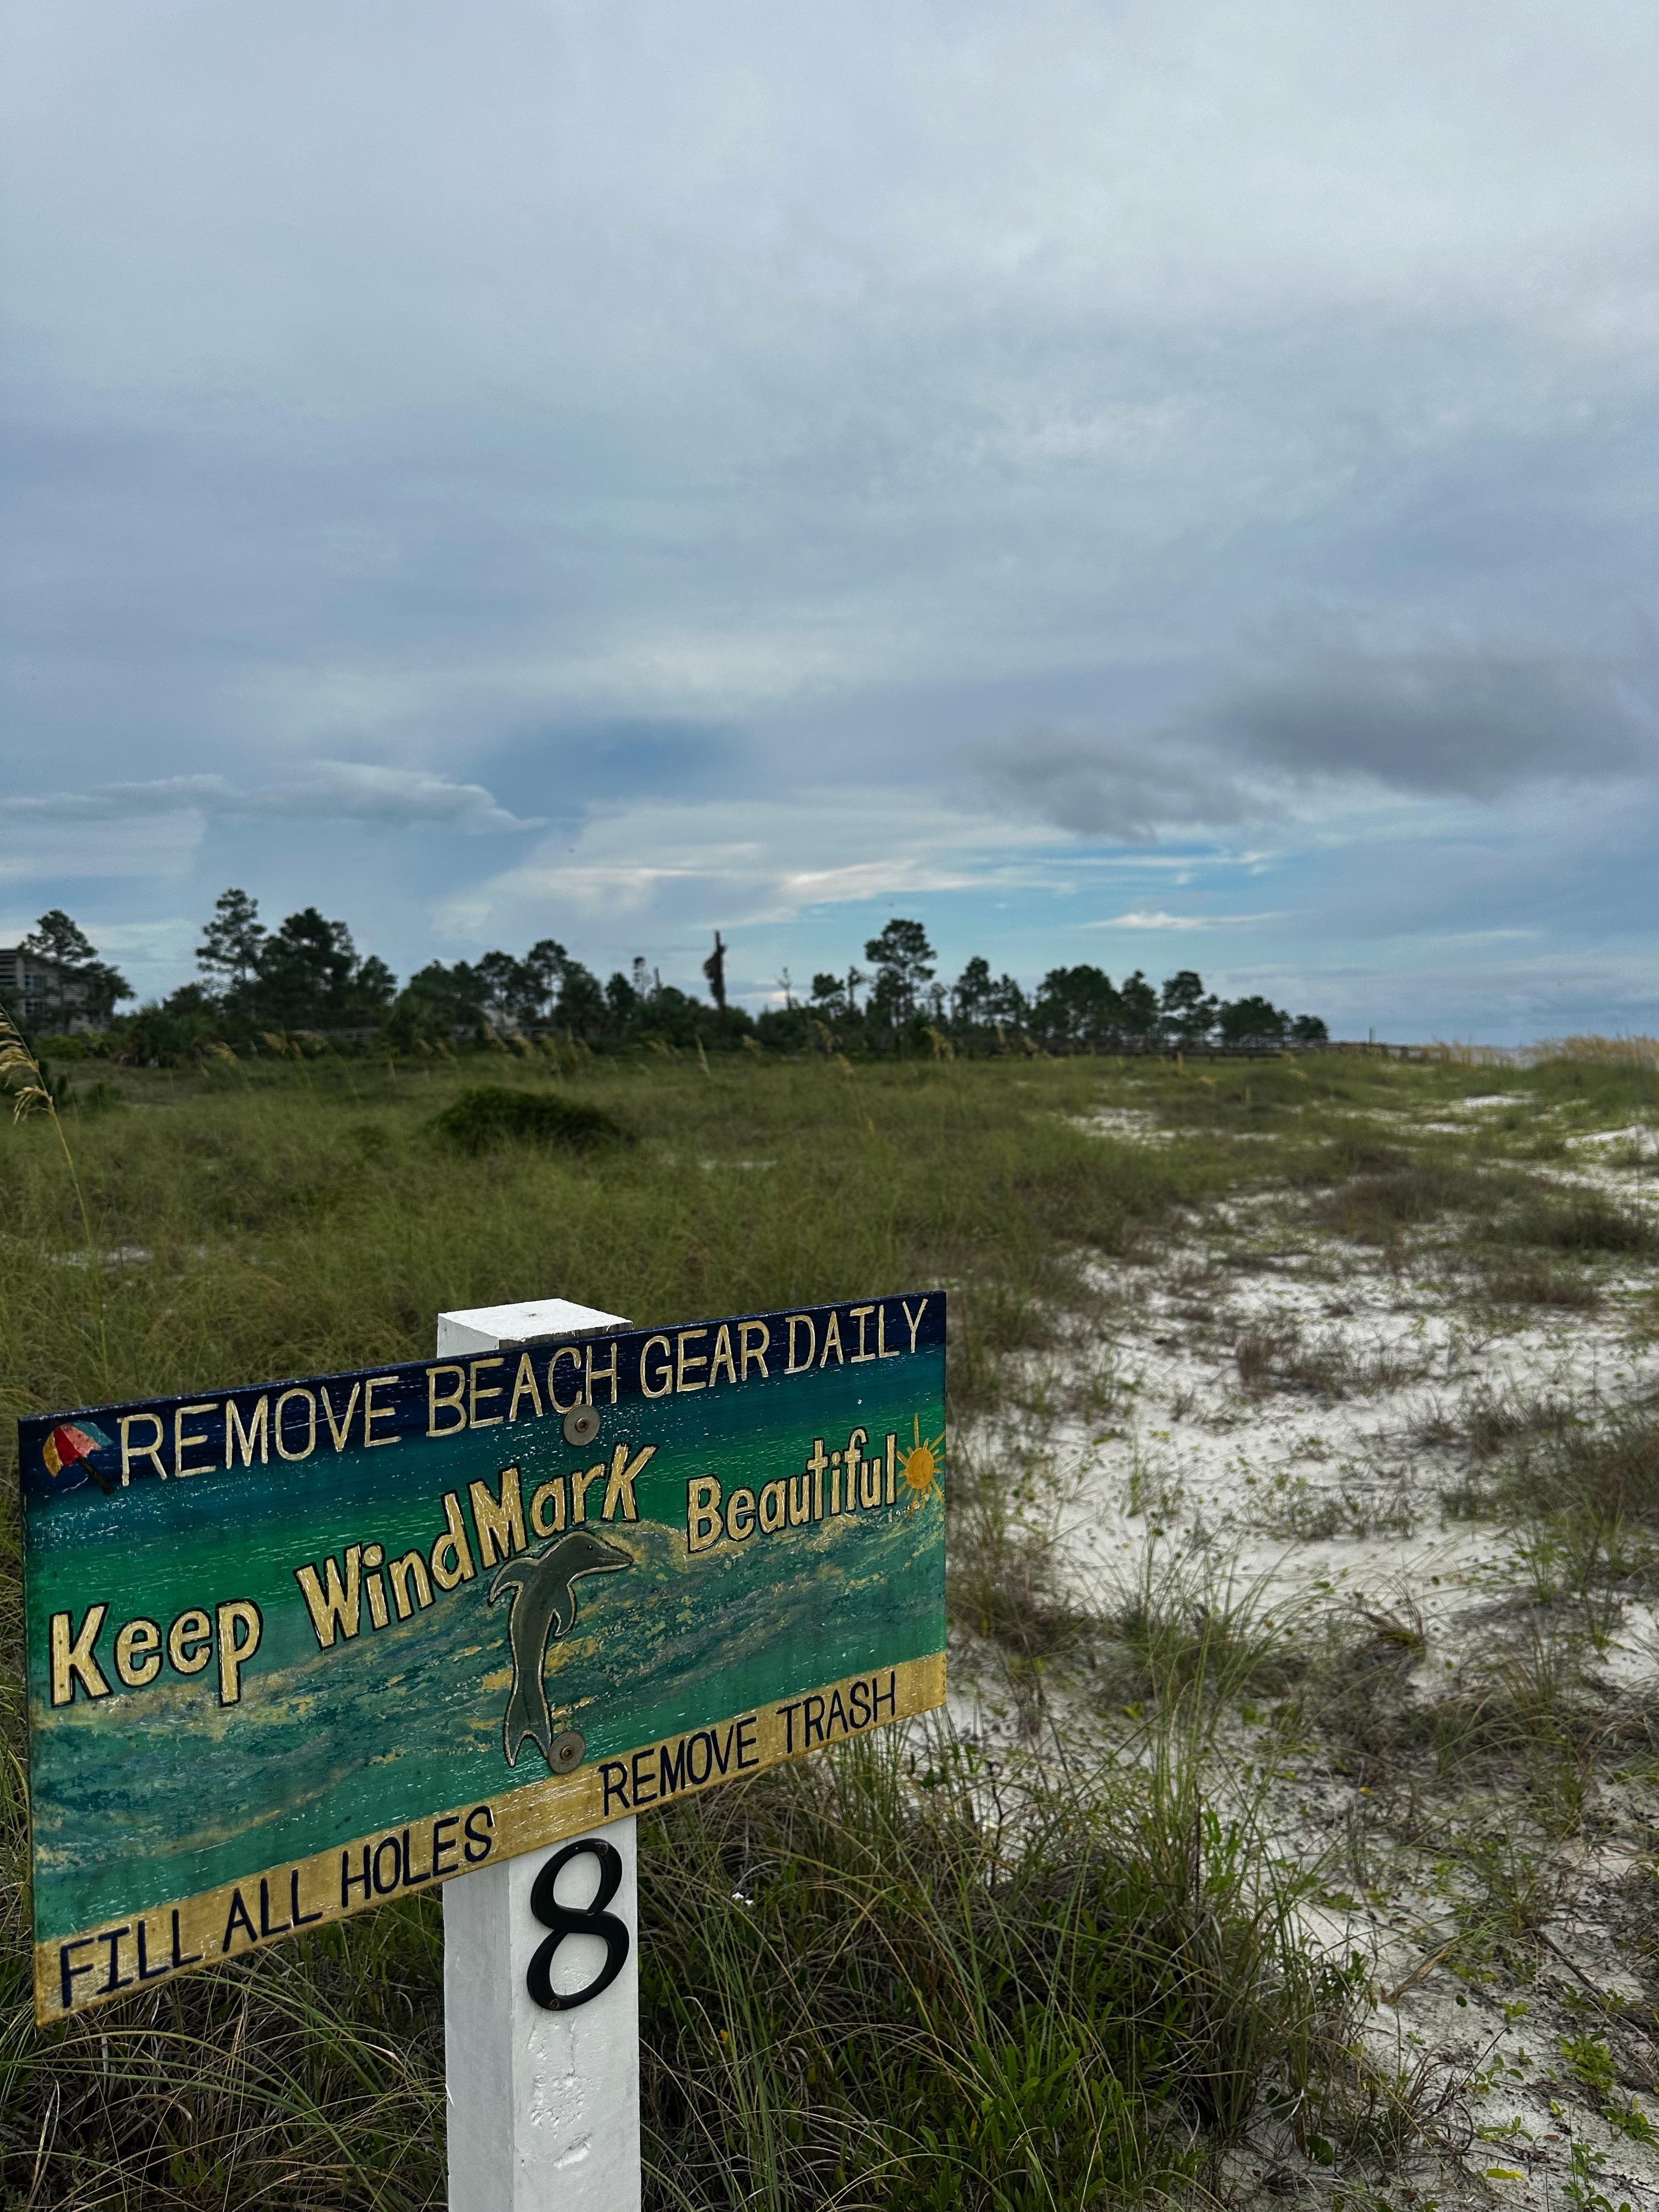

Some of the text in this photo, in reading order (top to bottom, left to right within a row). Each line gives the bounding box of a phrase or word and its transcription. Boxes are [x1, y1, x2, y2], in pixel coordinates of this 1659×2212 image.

[117, 1298, 928, 1486] REMOVE BEACH GEAR DAILY
[50, 1598, 263, 1708] Keep
[686, 1427, 898, 1554] Beautiful
[598, 1672, 896, 1816] REMOVE TRASH
[59, 1805, 494, 2008] FILL ALL HOLES
[526, 1838, 630, 2012] 8
